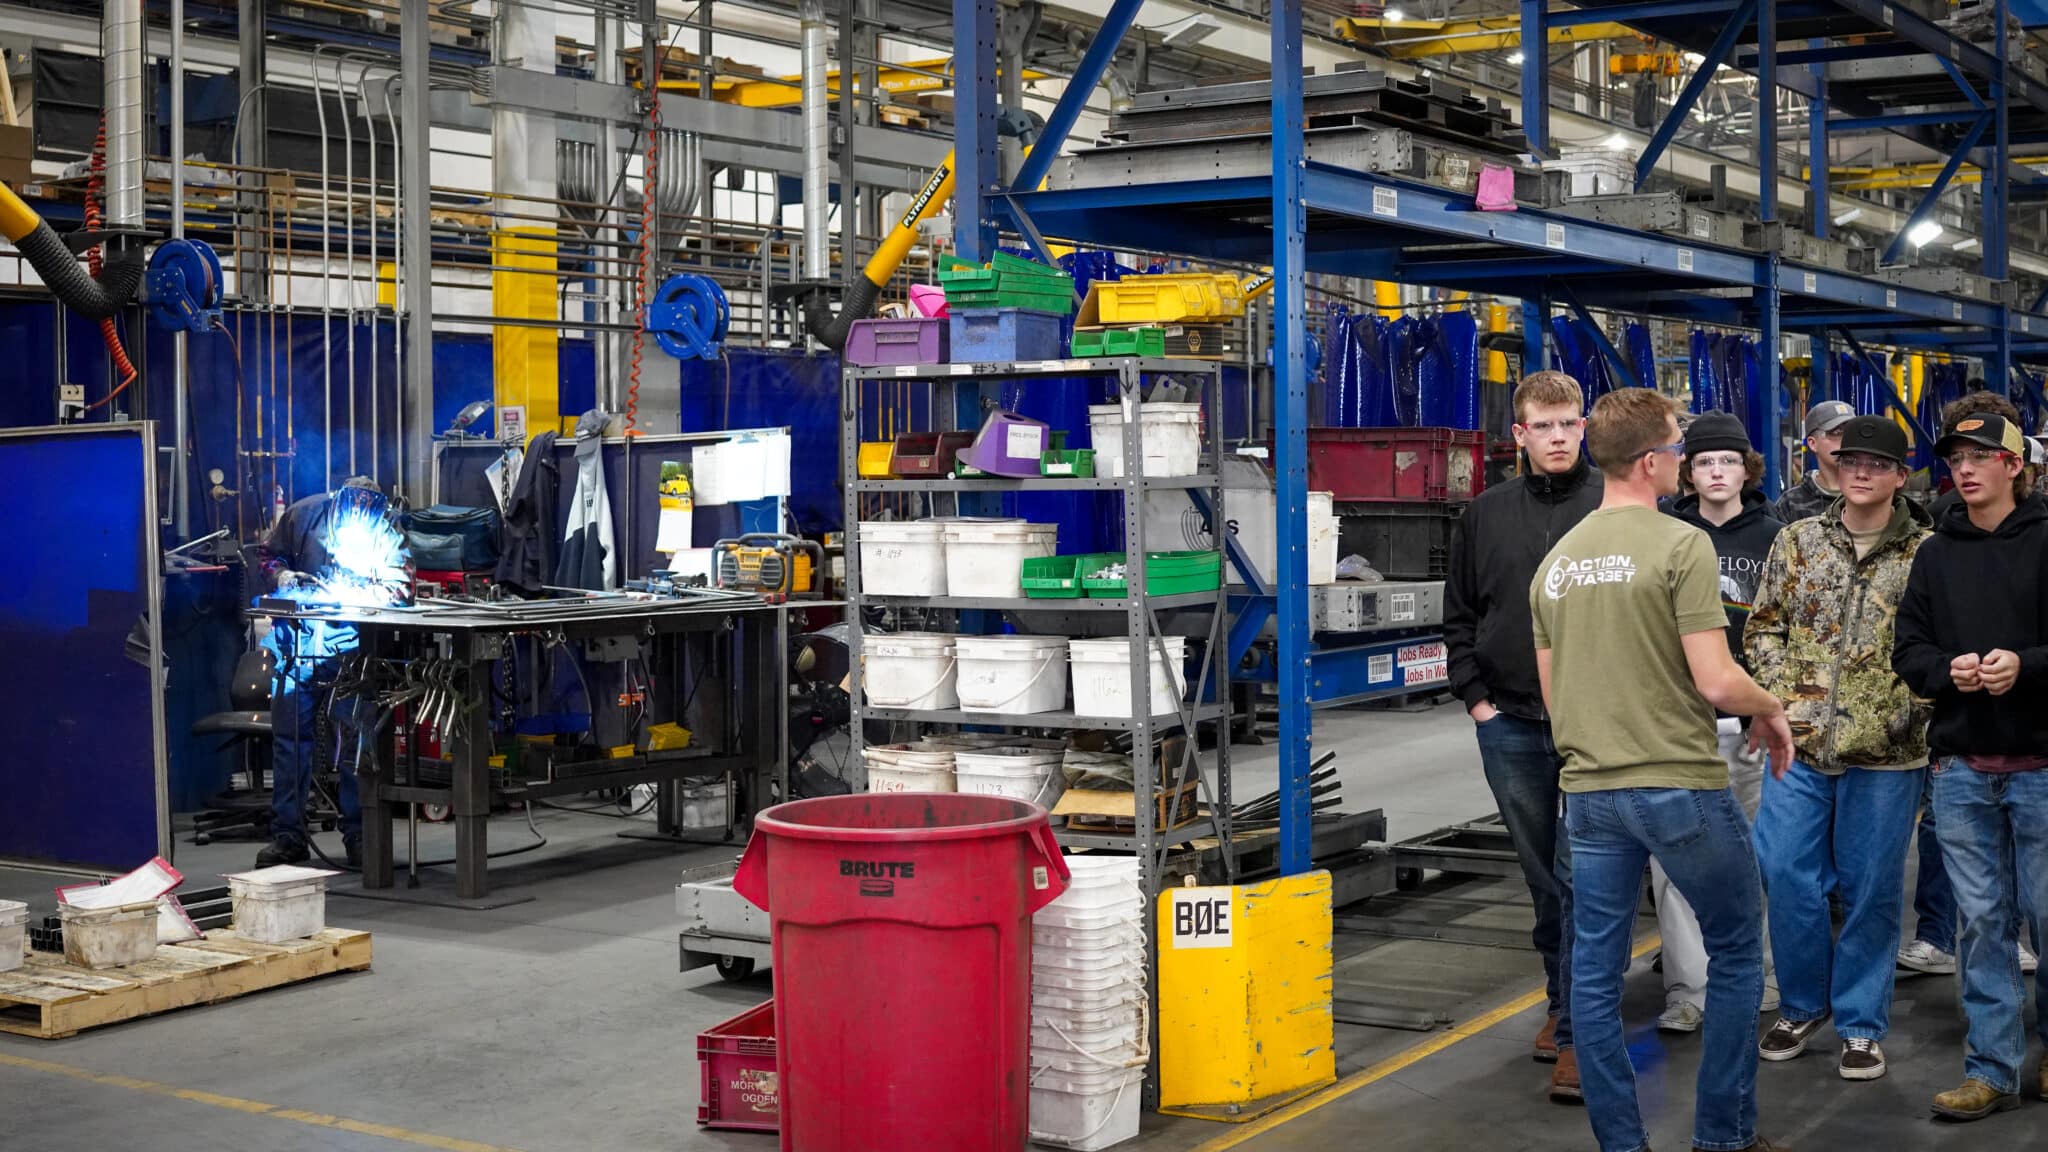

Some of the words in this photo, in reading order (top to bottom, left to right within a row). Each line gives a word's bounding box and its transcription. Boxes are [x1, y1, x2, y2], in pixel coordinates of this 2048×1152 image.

[902, 169, 947, 227] PLYMOVENT
[1565, 555, 1631, 574] ACTION
[1573, 570, 1636, 587] TARGET
[1398, 647, 1418, 663] Jobs
[1419, 642, 1441, 660] Ready
[1405, 667, 1424, 683] Jobs
[1425, 666, 1433, 681] In
[839, 859, 915, 879] BRUTE
[741, 1092, 778, 1105] OGDEN
